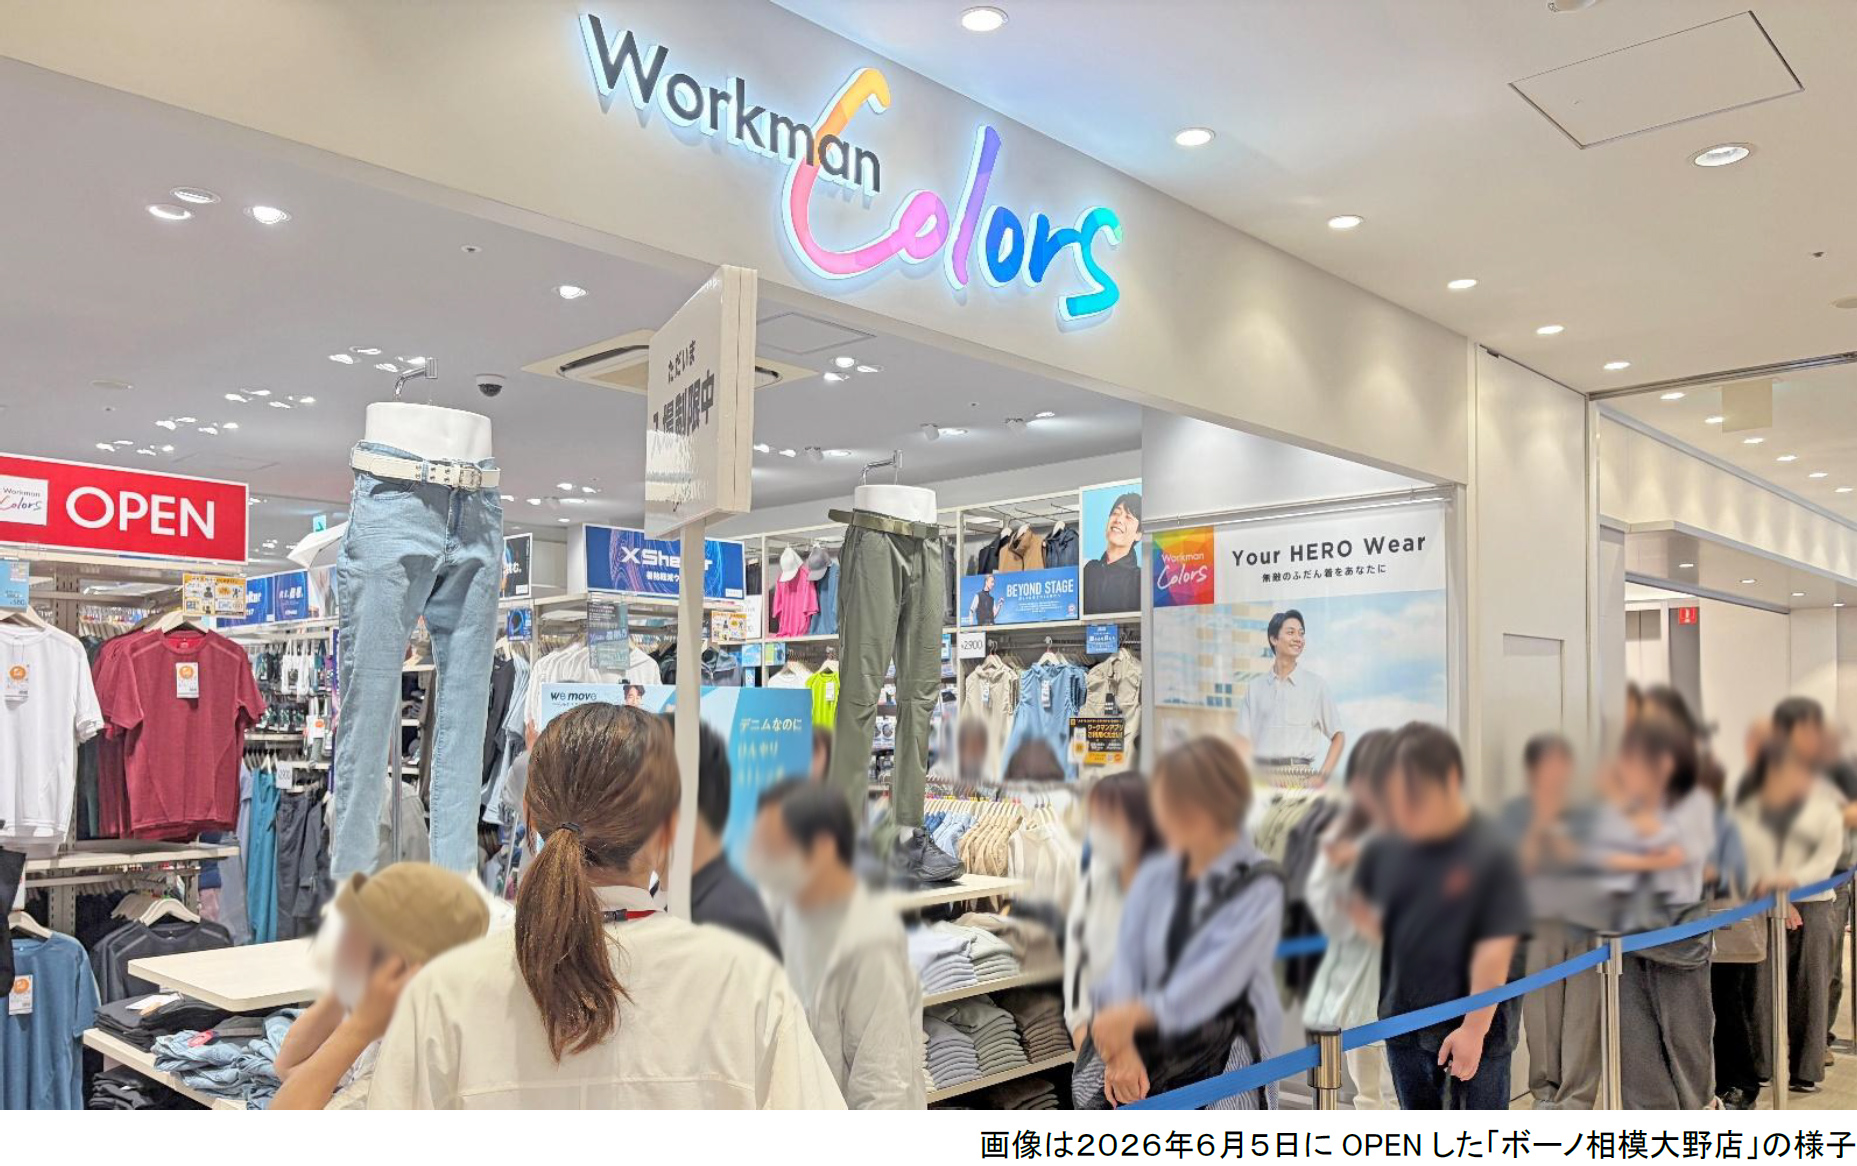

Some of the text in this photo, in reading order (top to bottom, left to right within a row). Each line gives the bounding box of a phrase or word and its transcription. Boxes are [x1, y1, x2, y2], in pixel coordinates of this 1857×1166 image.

[580, 13, 881, 193] Workman
[787, 67, 1123, 319] Colors
[668, 339, 697, 384] ただいま
[3, 486, 41, 497] Workman
[66, 486, 215, 540] OPEN
[1161, 552, 1205, 564] Workman
[1232, 535, 1427, 567] Your HERO Wear
[1156, 564, 1208, 590] Colors
[1262, 563, 1387, 583] 無敵のふだん着をあなたに
[1006, 582, 1042, 598] BEYOND
[1044, 578, 1074, 595] STAGE
[550, 692, 597, 700] we move
[740, 717, 803, 731] デニムなのに
